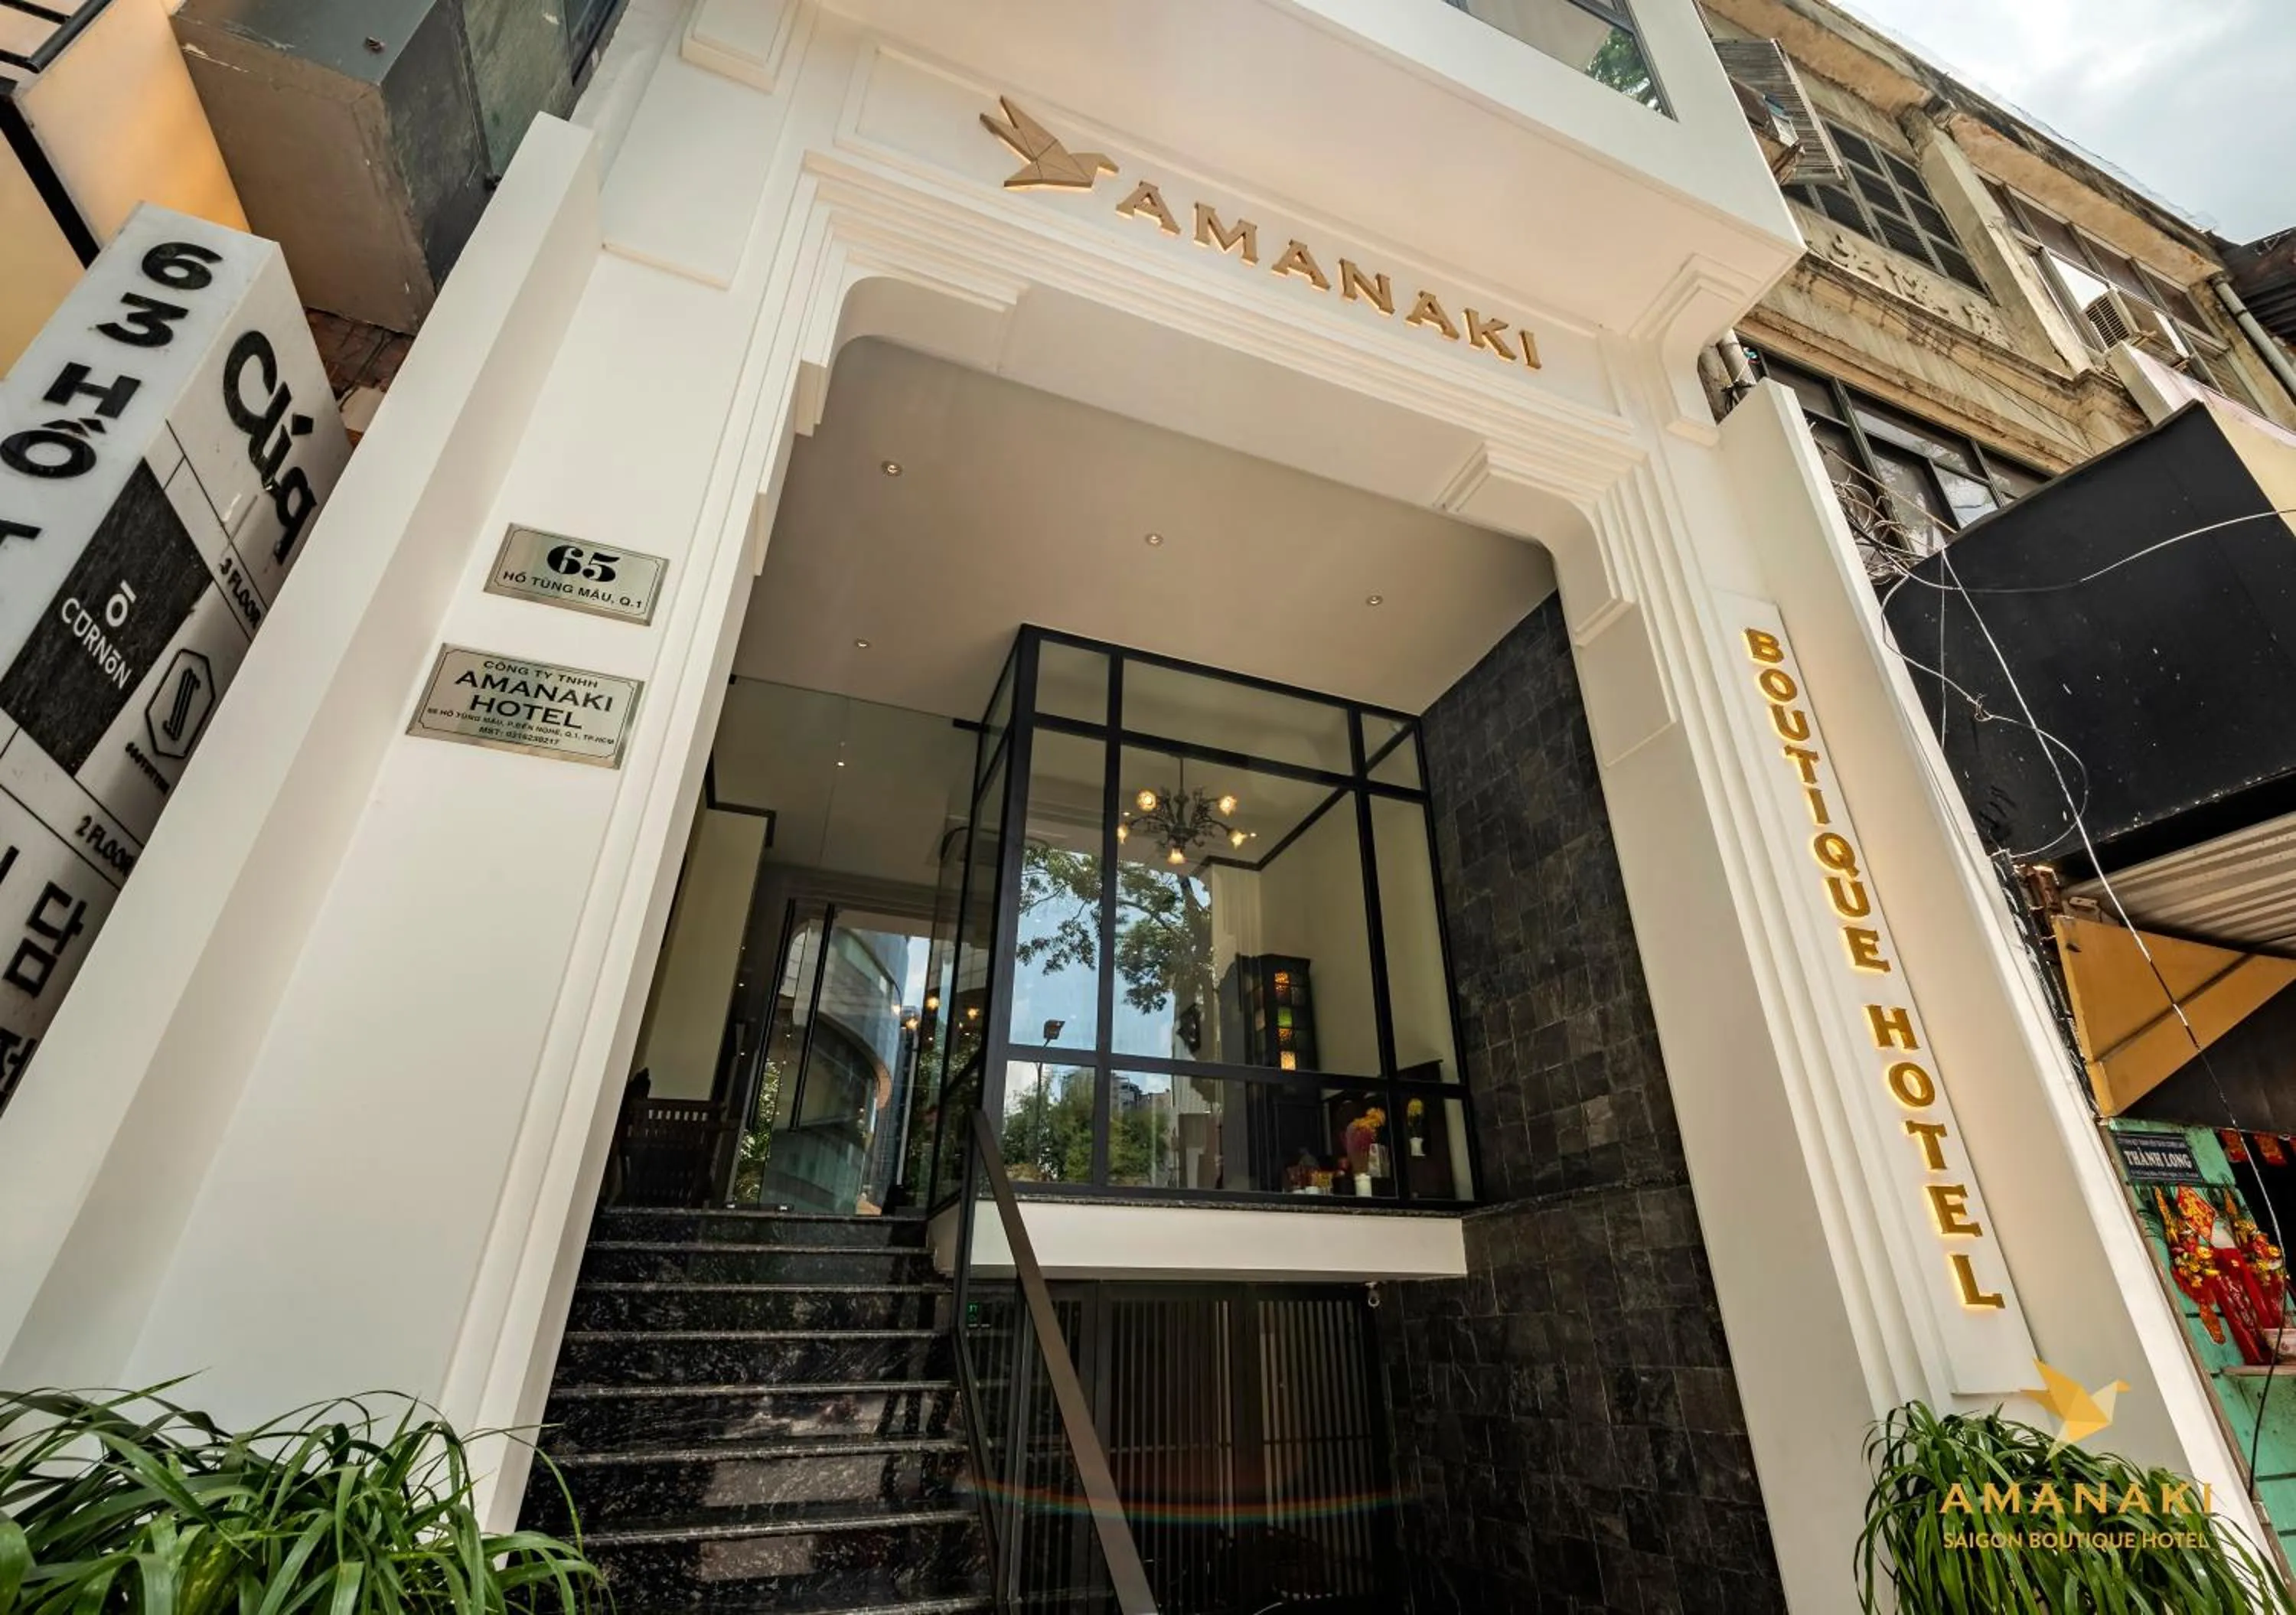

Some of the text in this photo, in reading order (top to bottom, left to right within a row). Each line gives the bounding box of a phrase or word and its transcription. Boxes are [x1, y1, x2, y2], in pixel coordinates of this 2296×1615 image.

[1115, 181, 1541, 369] AMANAKI
[96, 242, 223, 347] 63
[546, 544, 620, 582] 65
[227, 569, 261, 629] FLOOR
[619, 596, 642, 609] Q.1
[455, 670, 613, 713] AMANAKI
[484, 660, 598, 688] CÔNG TY TNHH
[469, 694, 582, 729] HOTEL
[75, 815, 92, 837] 2
[1740, 626, 2005, 1310] BOUTIQUE HOTEL
[2161, 1153, 2193, 1169] LONG
